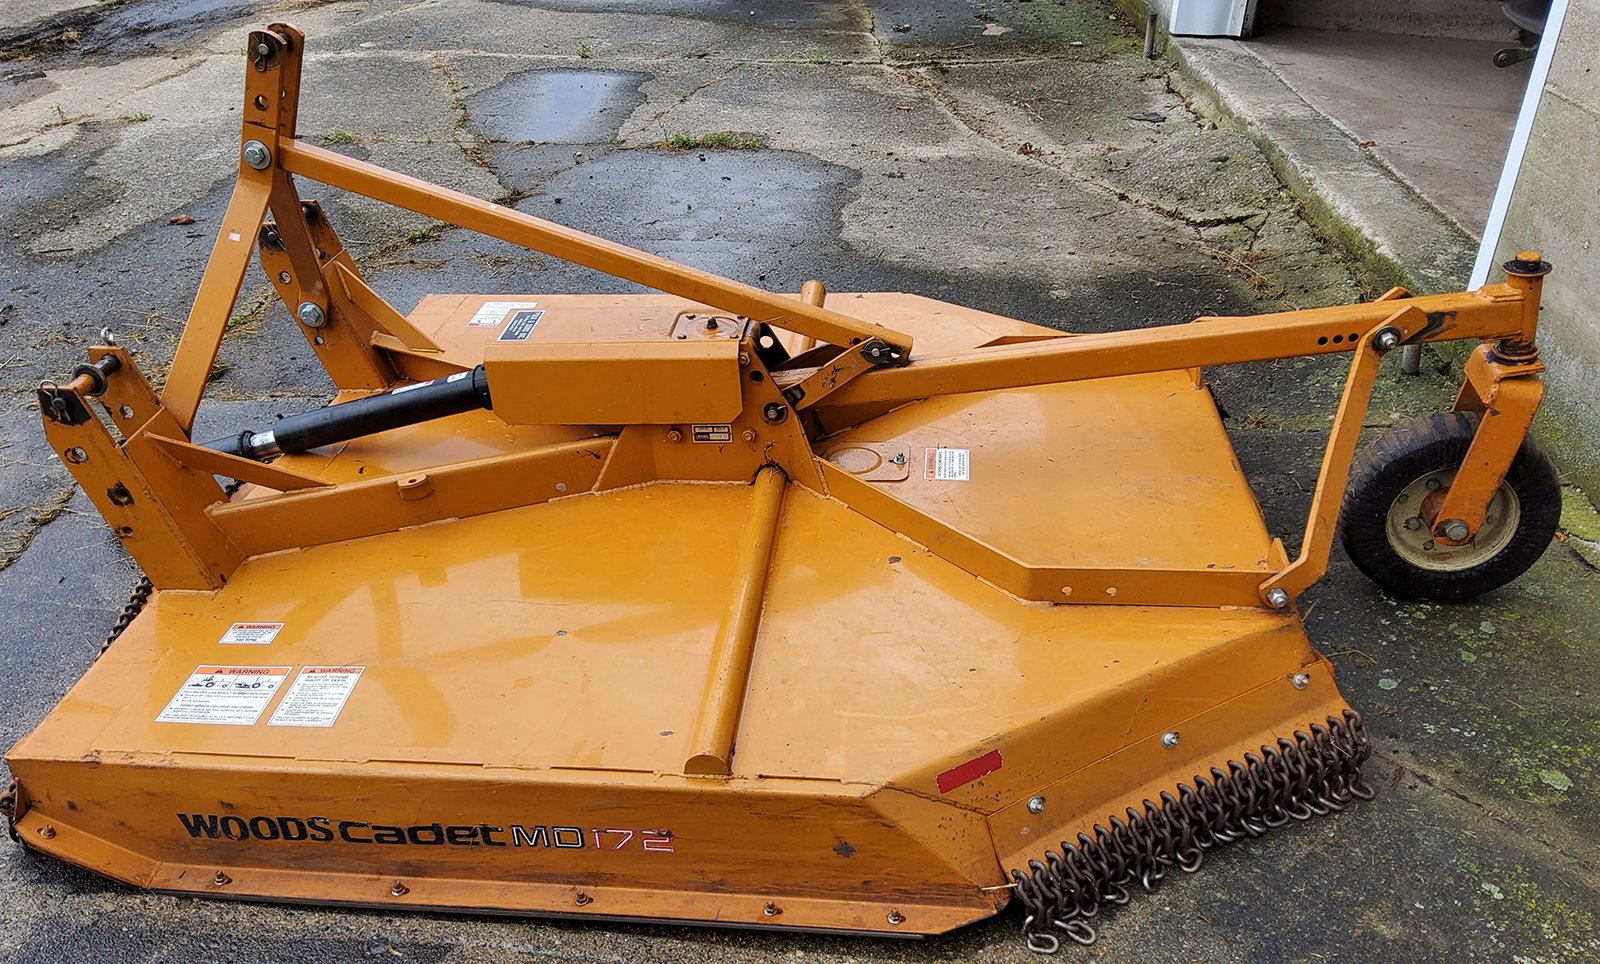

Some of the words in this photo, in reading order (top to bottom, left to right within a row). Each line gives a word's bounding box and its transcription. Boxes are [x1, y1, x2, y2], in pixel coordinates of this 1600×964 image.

[176, 813, 334, 842] WOODS
[338, 820, 507, 847] Cadet
[509, 824, 585, 849] MD
